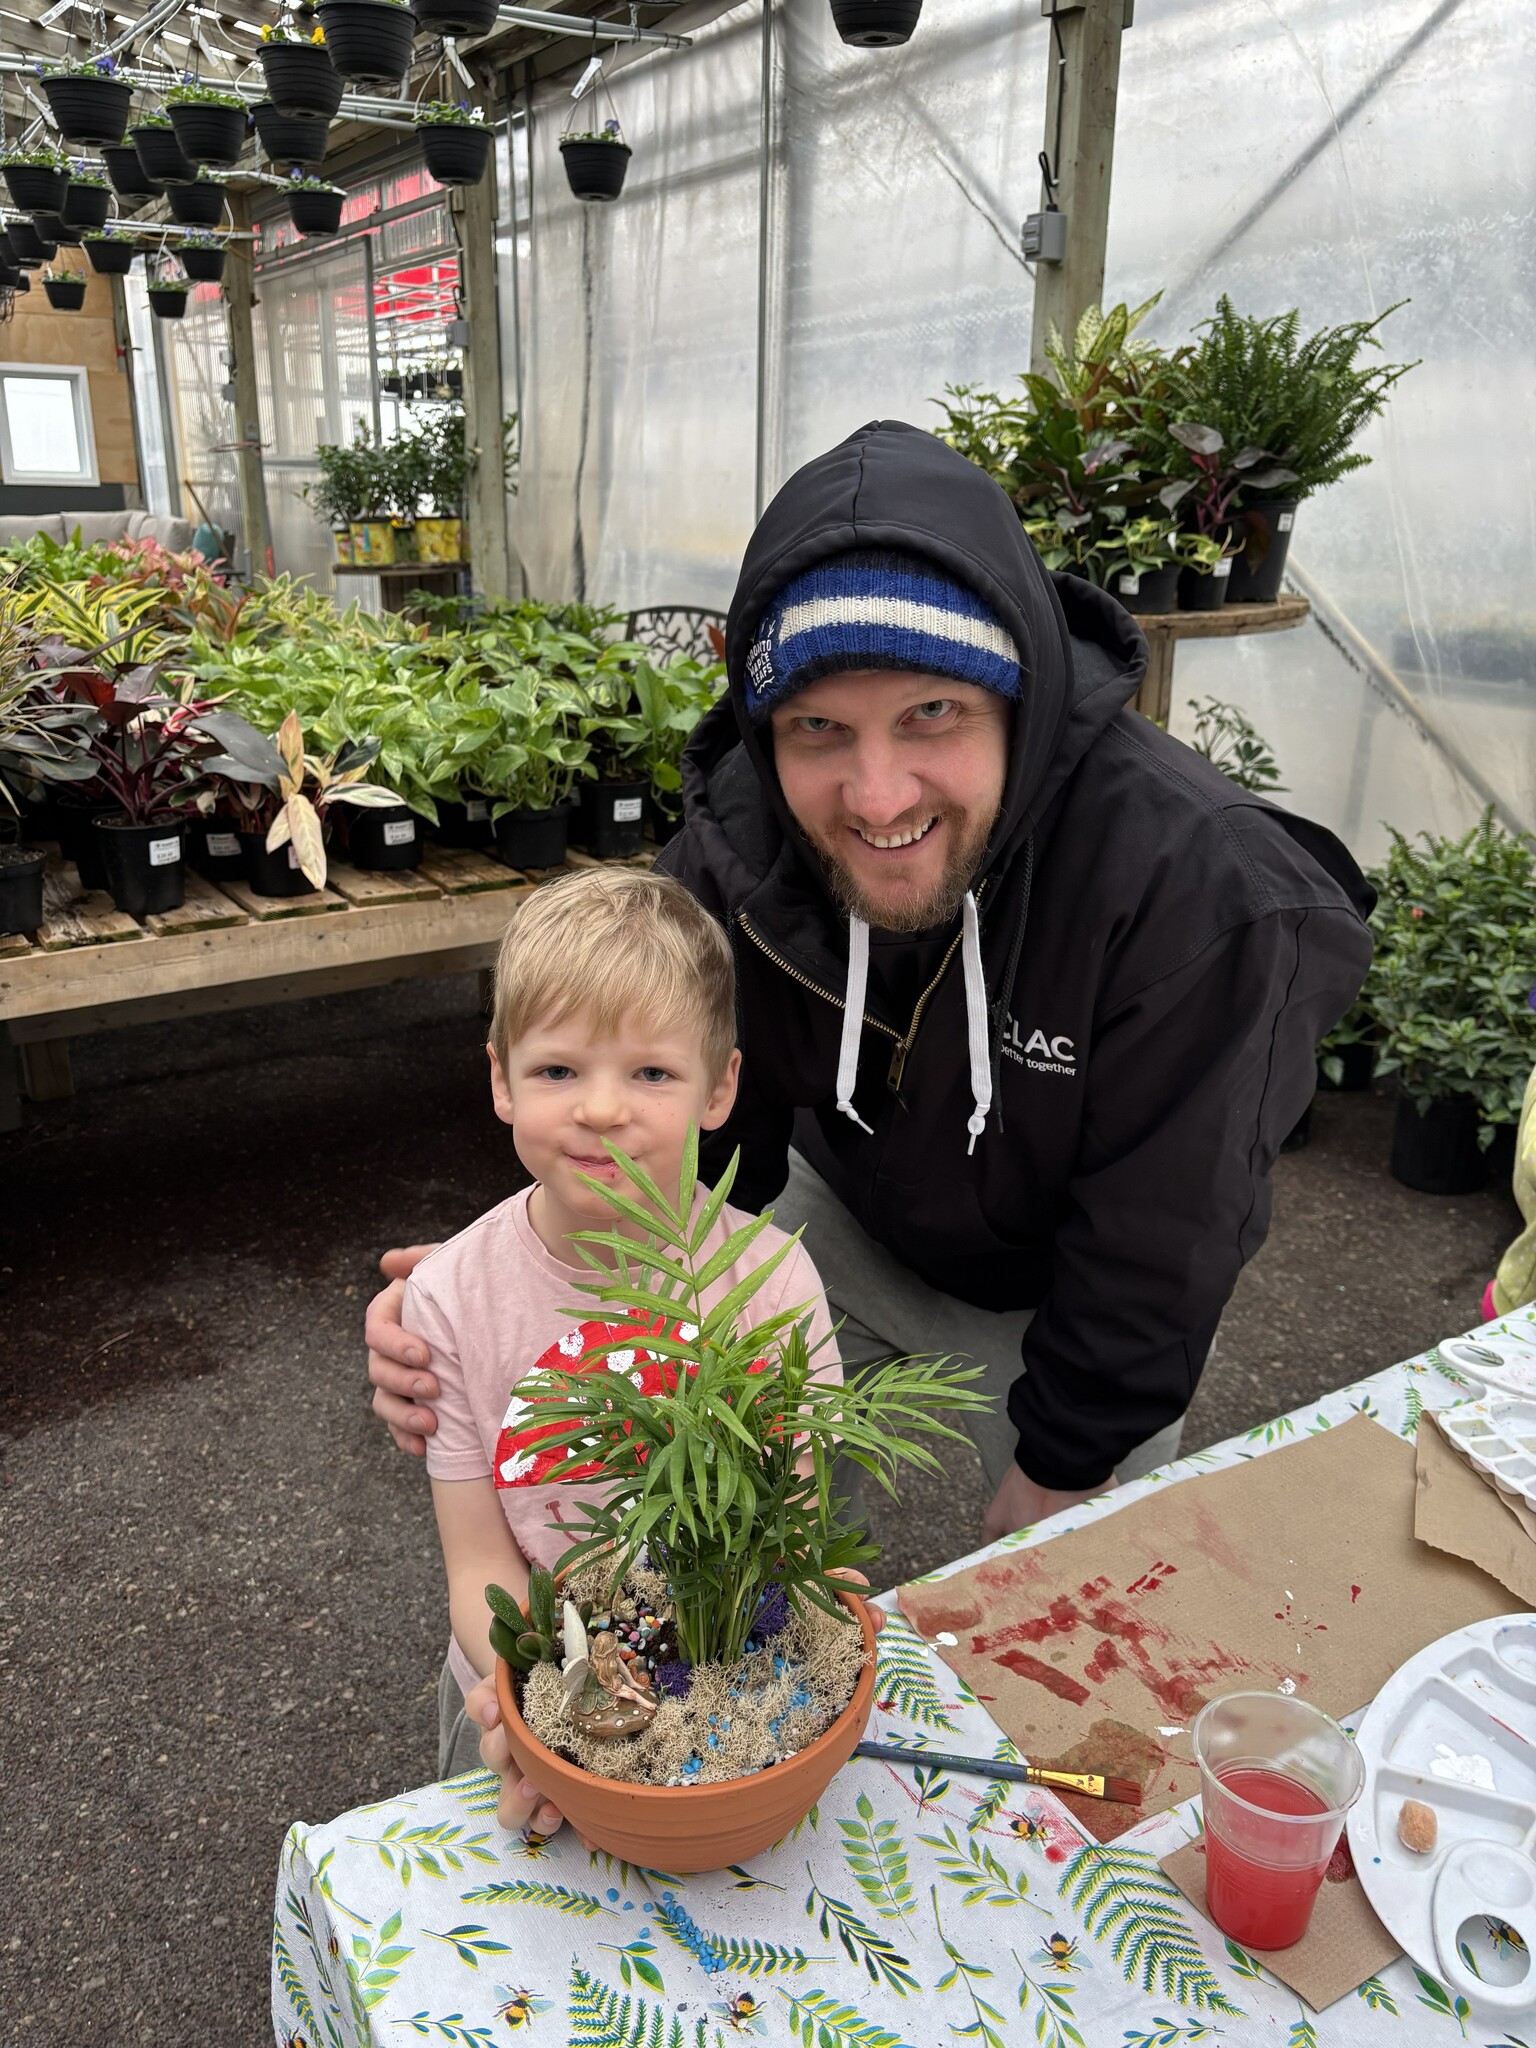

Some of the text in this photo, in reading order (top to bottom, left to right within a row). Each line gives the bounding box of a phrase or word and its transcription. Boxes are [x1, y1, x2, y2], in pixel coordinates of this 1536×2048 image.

[750, 651, 770, 678] MAPLE
[752, 662, 773, 687] LEAFS
[1026, 1058, 1077, 1077] together
